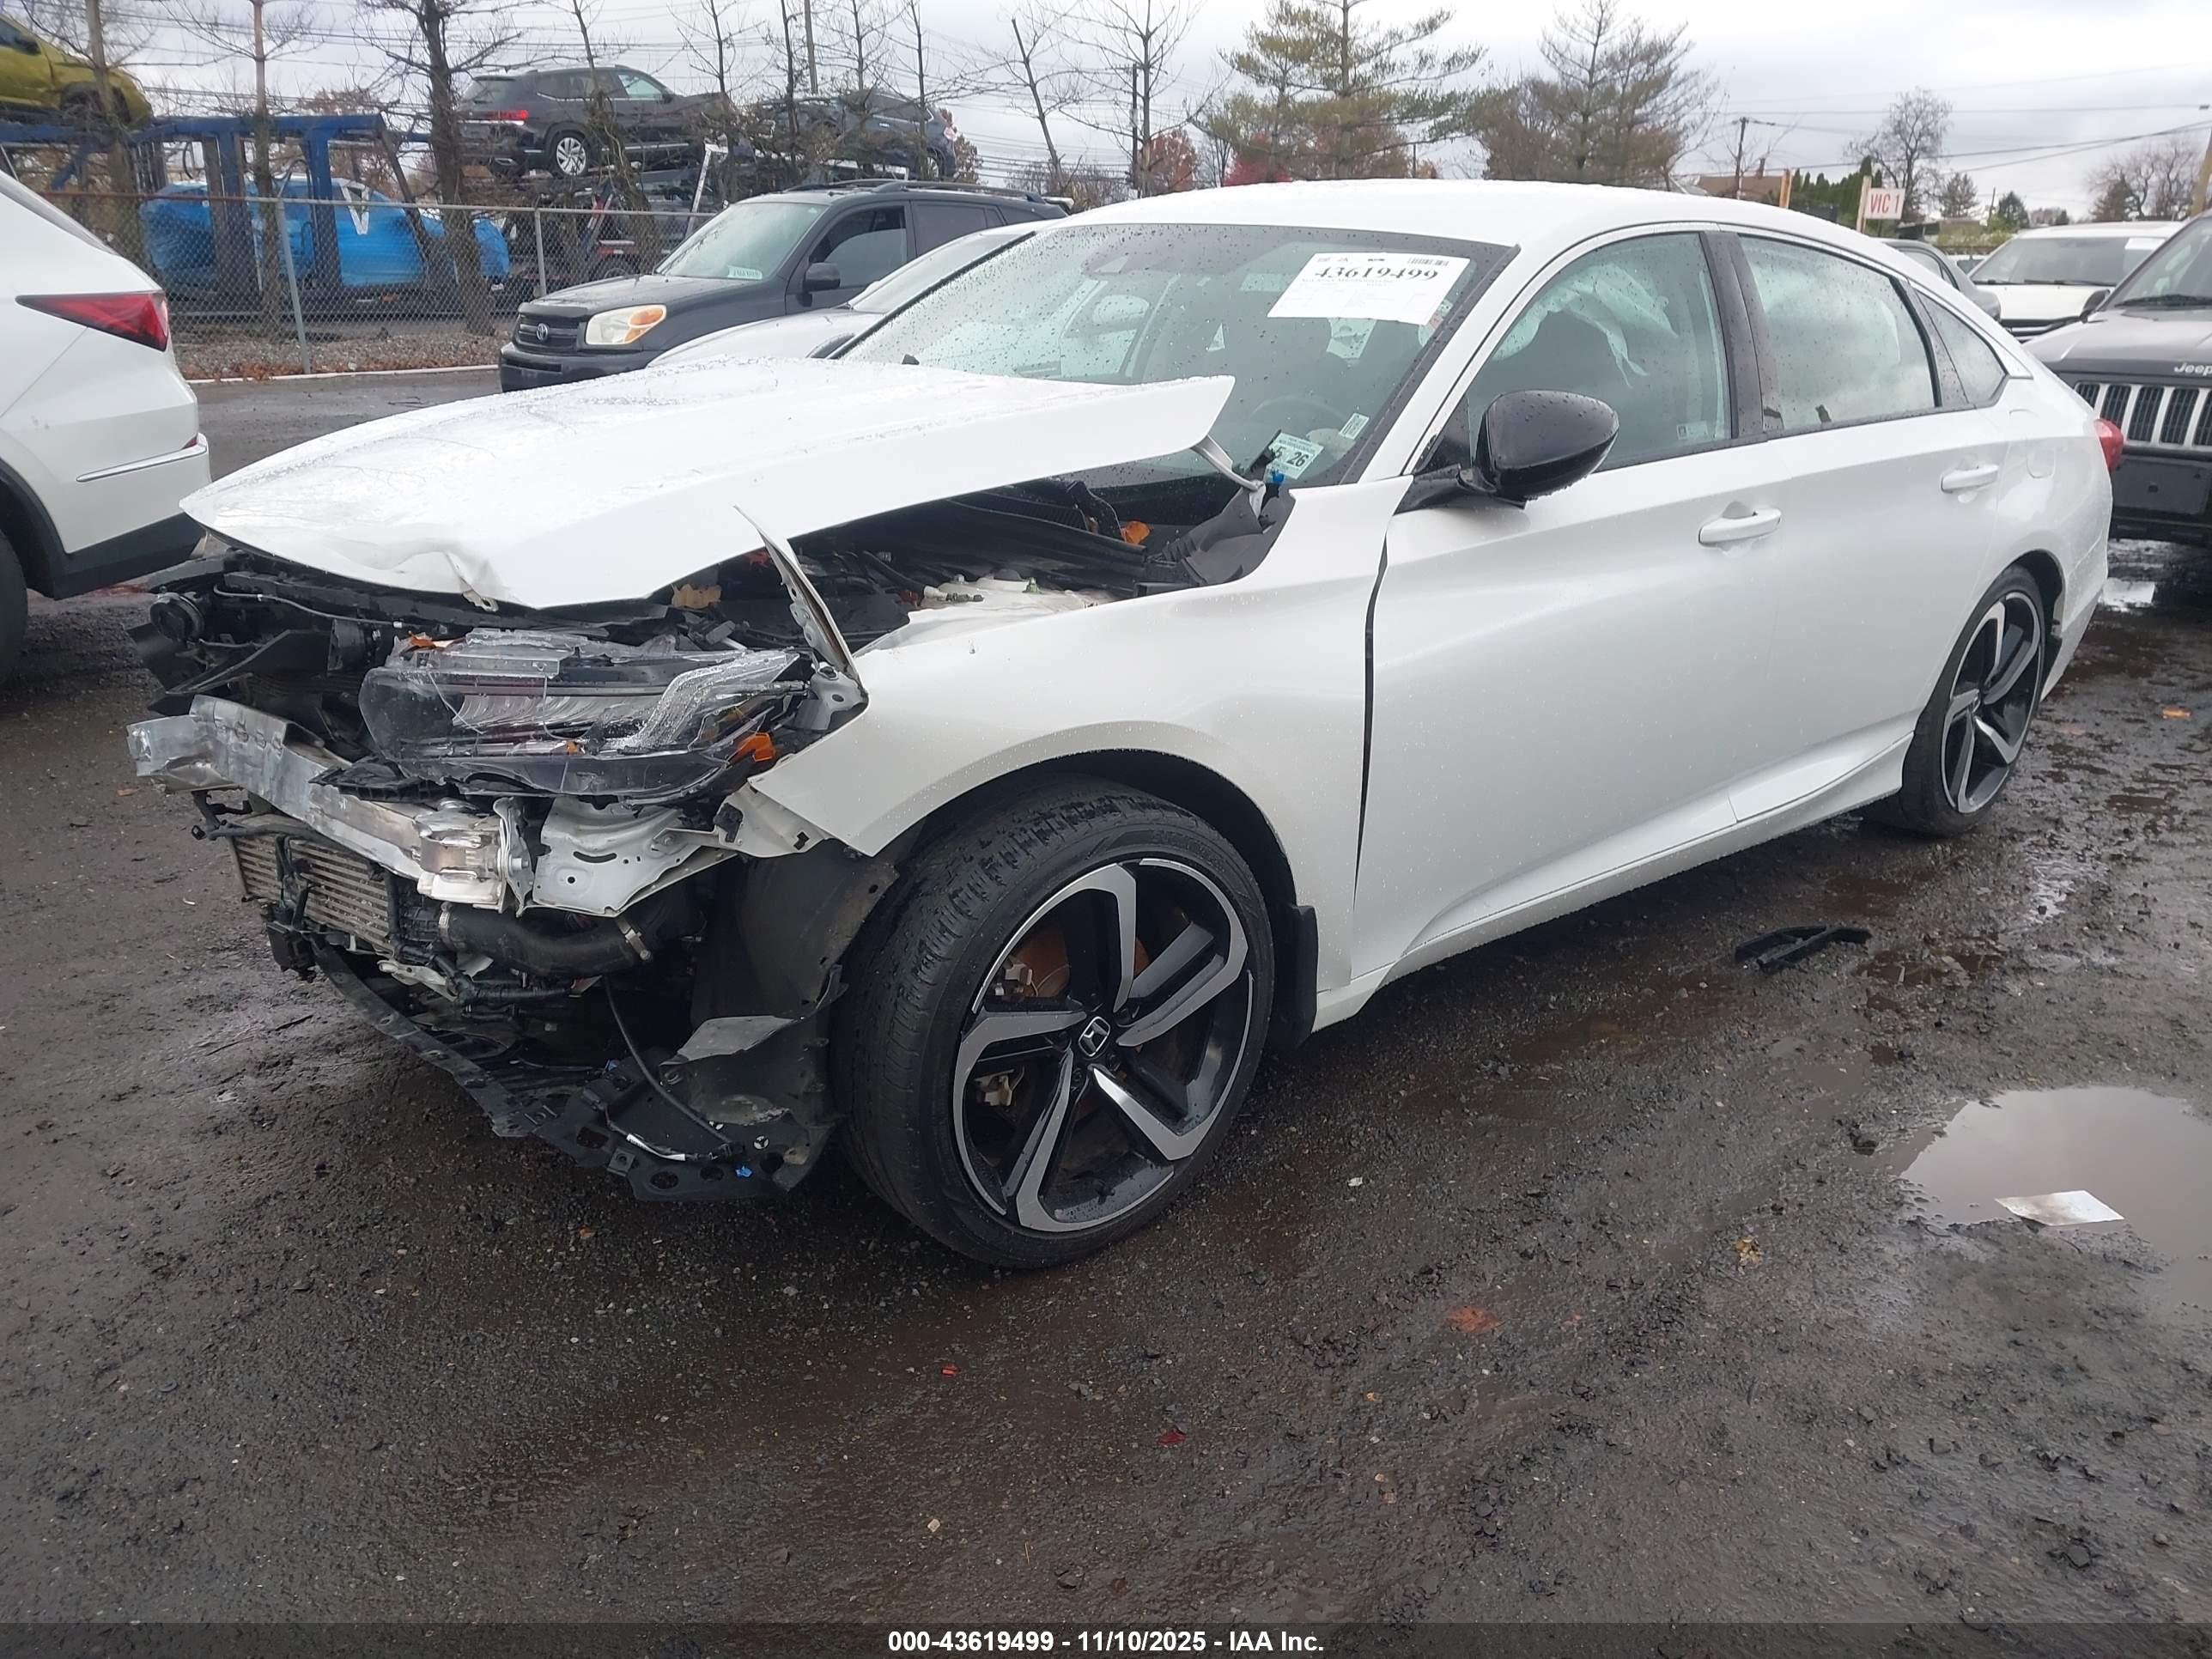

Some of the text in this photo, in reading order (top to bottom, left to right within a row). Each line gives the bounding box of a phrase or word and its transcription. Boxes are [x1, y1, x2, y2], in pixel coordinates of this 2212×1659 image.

[1870, 193, 1900, 214] VIC 1
[1316, 266, 1439, 281] 43619499
[2173, 362, 2212, 377] Jeep
[1286, 451, 1310, 467] 26
